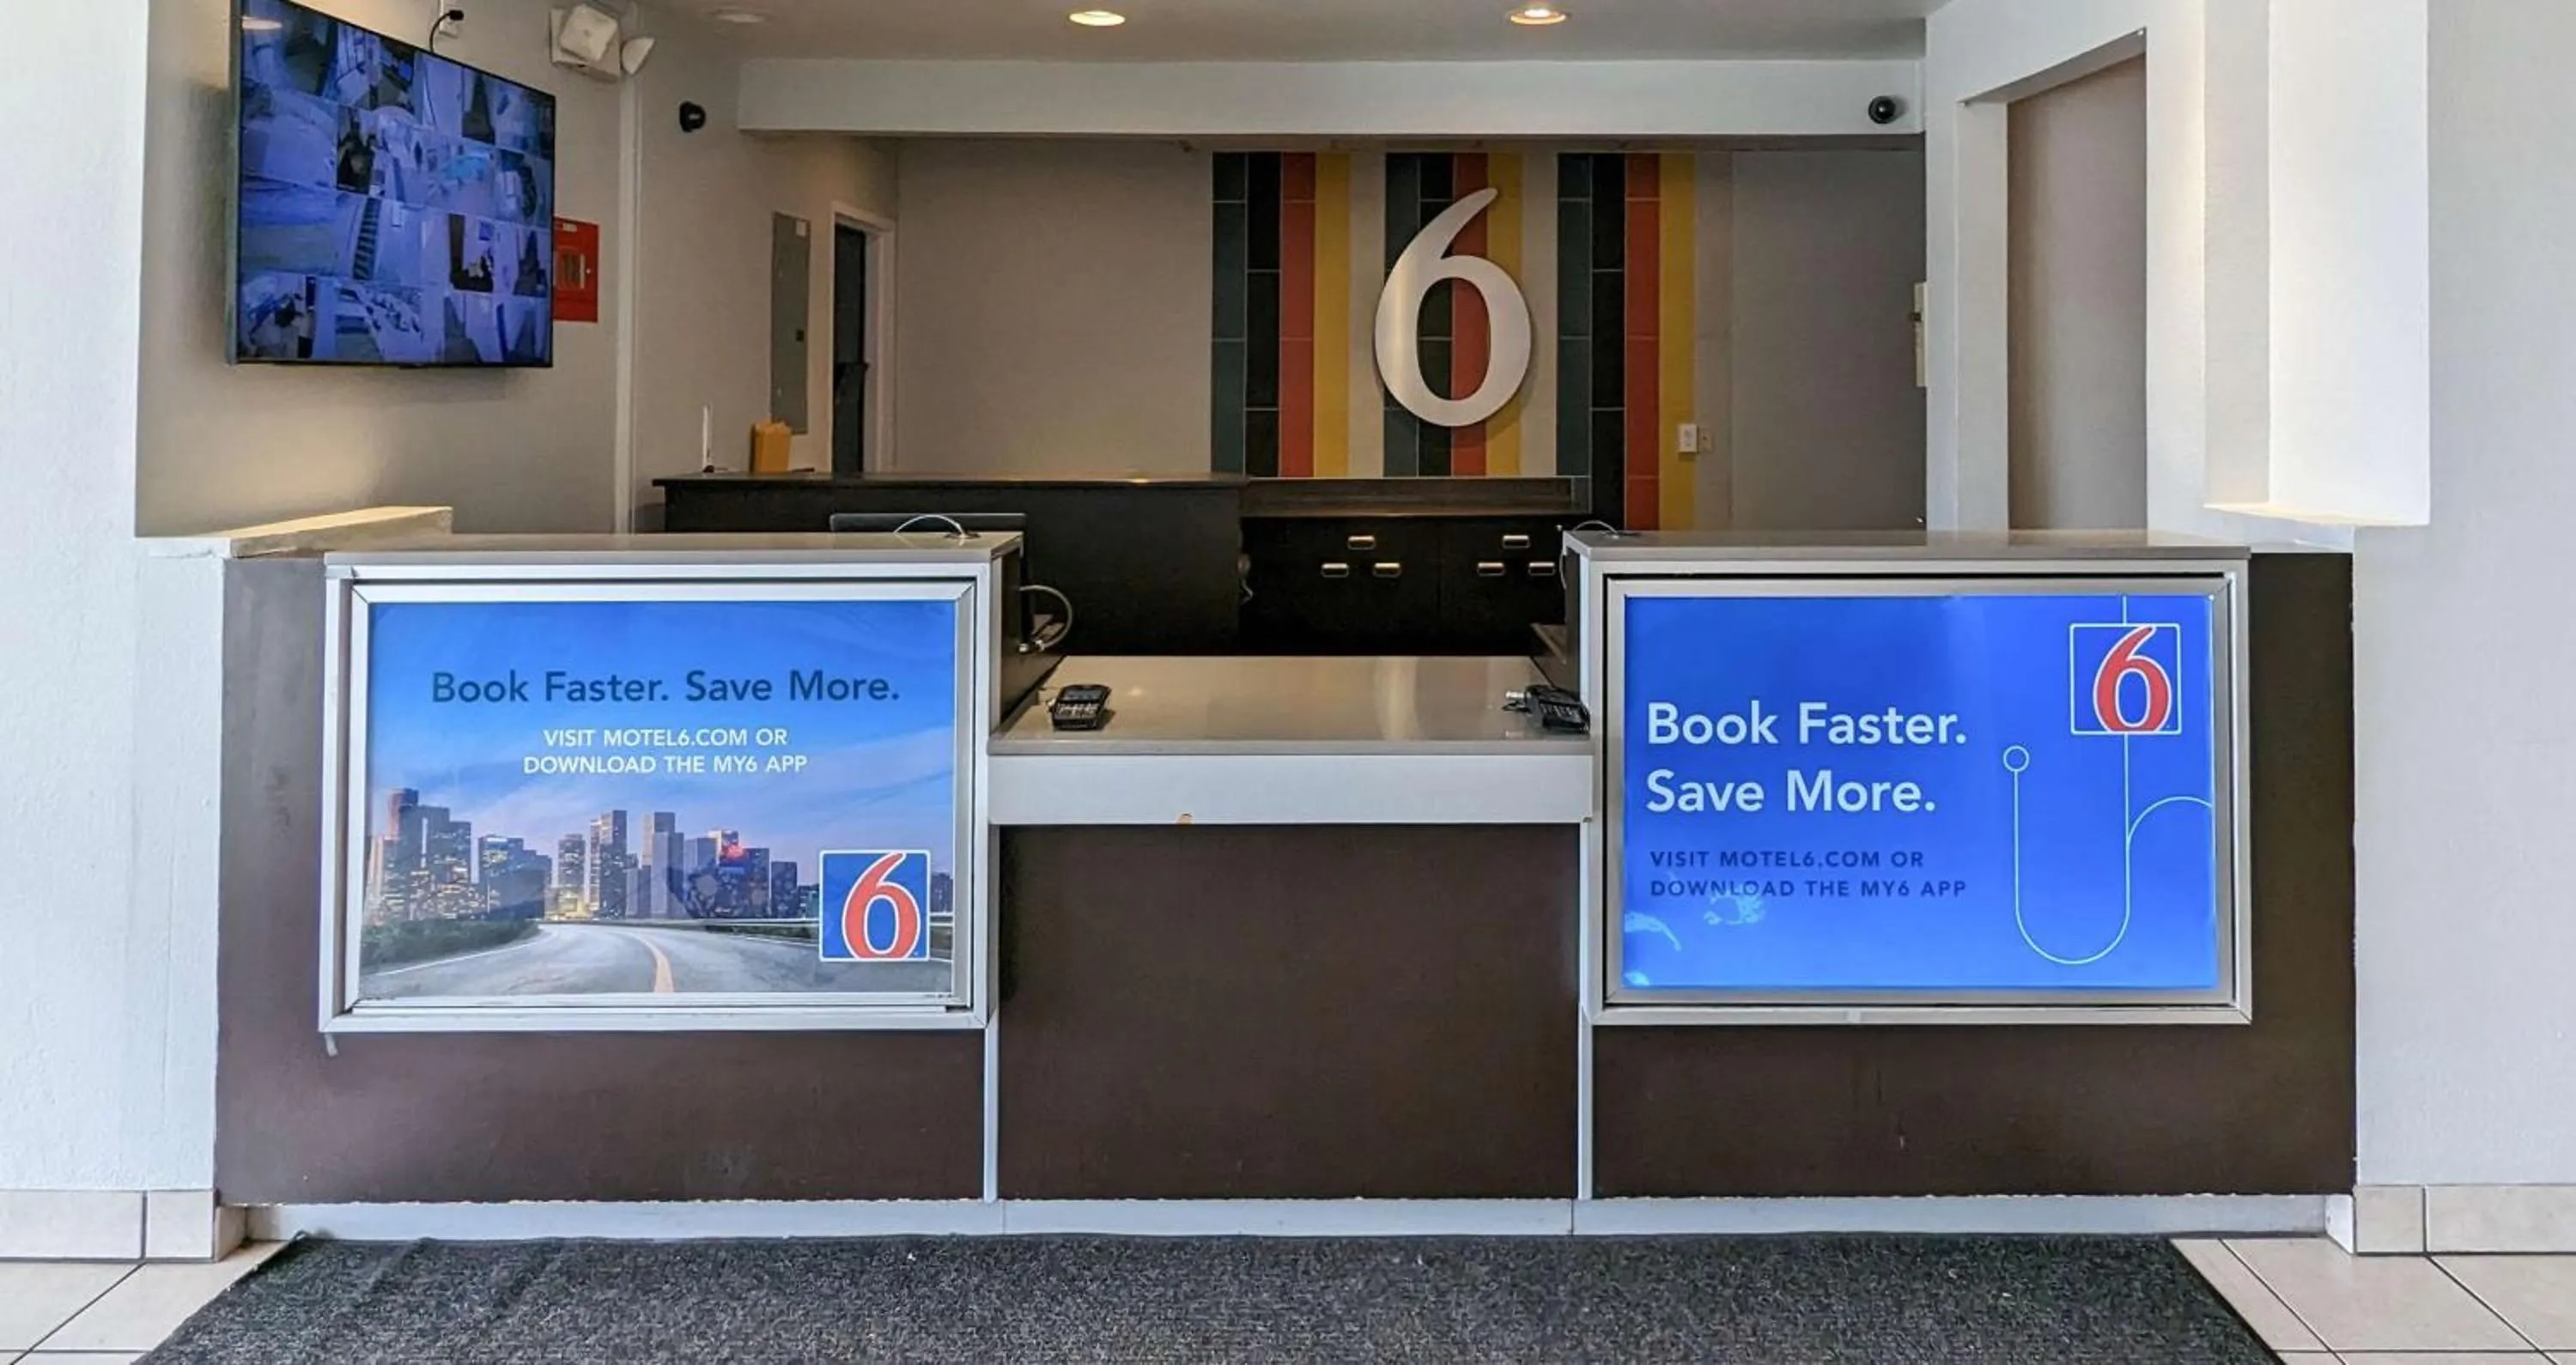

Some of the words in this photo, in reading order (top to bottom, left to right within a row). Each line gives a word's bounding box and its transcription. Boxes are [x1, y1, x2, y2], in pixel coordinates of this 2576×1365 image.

[1375, 187, 1532, 427] 6
[432, 670, 529, 702] Book
[544, 670, 669, 701] Faster.
[685, 670, 773, 701] Save
[789, 670, 900, 701] More.
[2093, 623, 2172, 735] 6
[543, 729, 596, 747] VISIT
[604, 728, 748, 747] MOTEL6.COM
[756, 728, 788, 746] OR
[1647, 700, 1779, 744] Book
[1799, 701, 1966, 745] Faster.
[523, 755, 657, 774] DOWNLOAD
[664, 755, 705, 774] THE
[714, 755, 757, 773] MY6
[765, 755, 808, 773] APP
[1646, 769, 1765, 812] Save
[1787, 769, 1935, 812] More.
[1650, 851, 1710, 868] VISIT
[1719, 850, 1880, 869] MOTEL6.COM
[1891, 851, 1924, 868] OR
[841, 849, 920, 961] 6
[1650, 880, 1795, 897] DOWNLOAD
[1805, 880, 1850, 897] THE
[1861, 880, 1911, 897] MY6
[1920, 880, 1967, 897] APP
